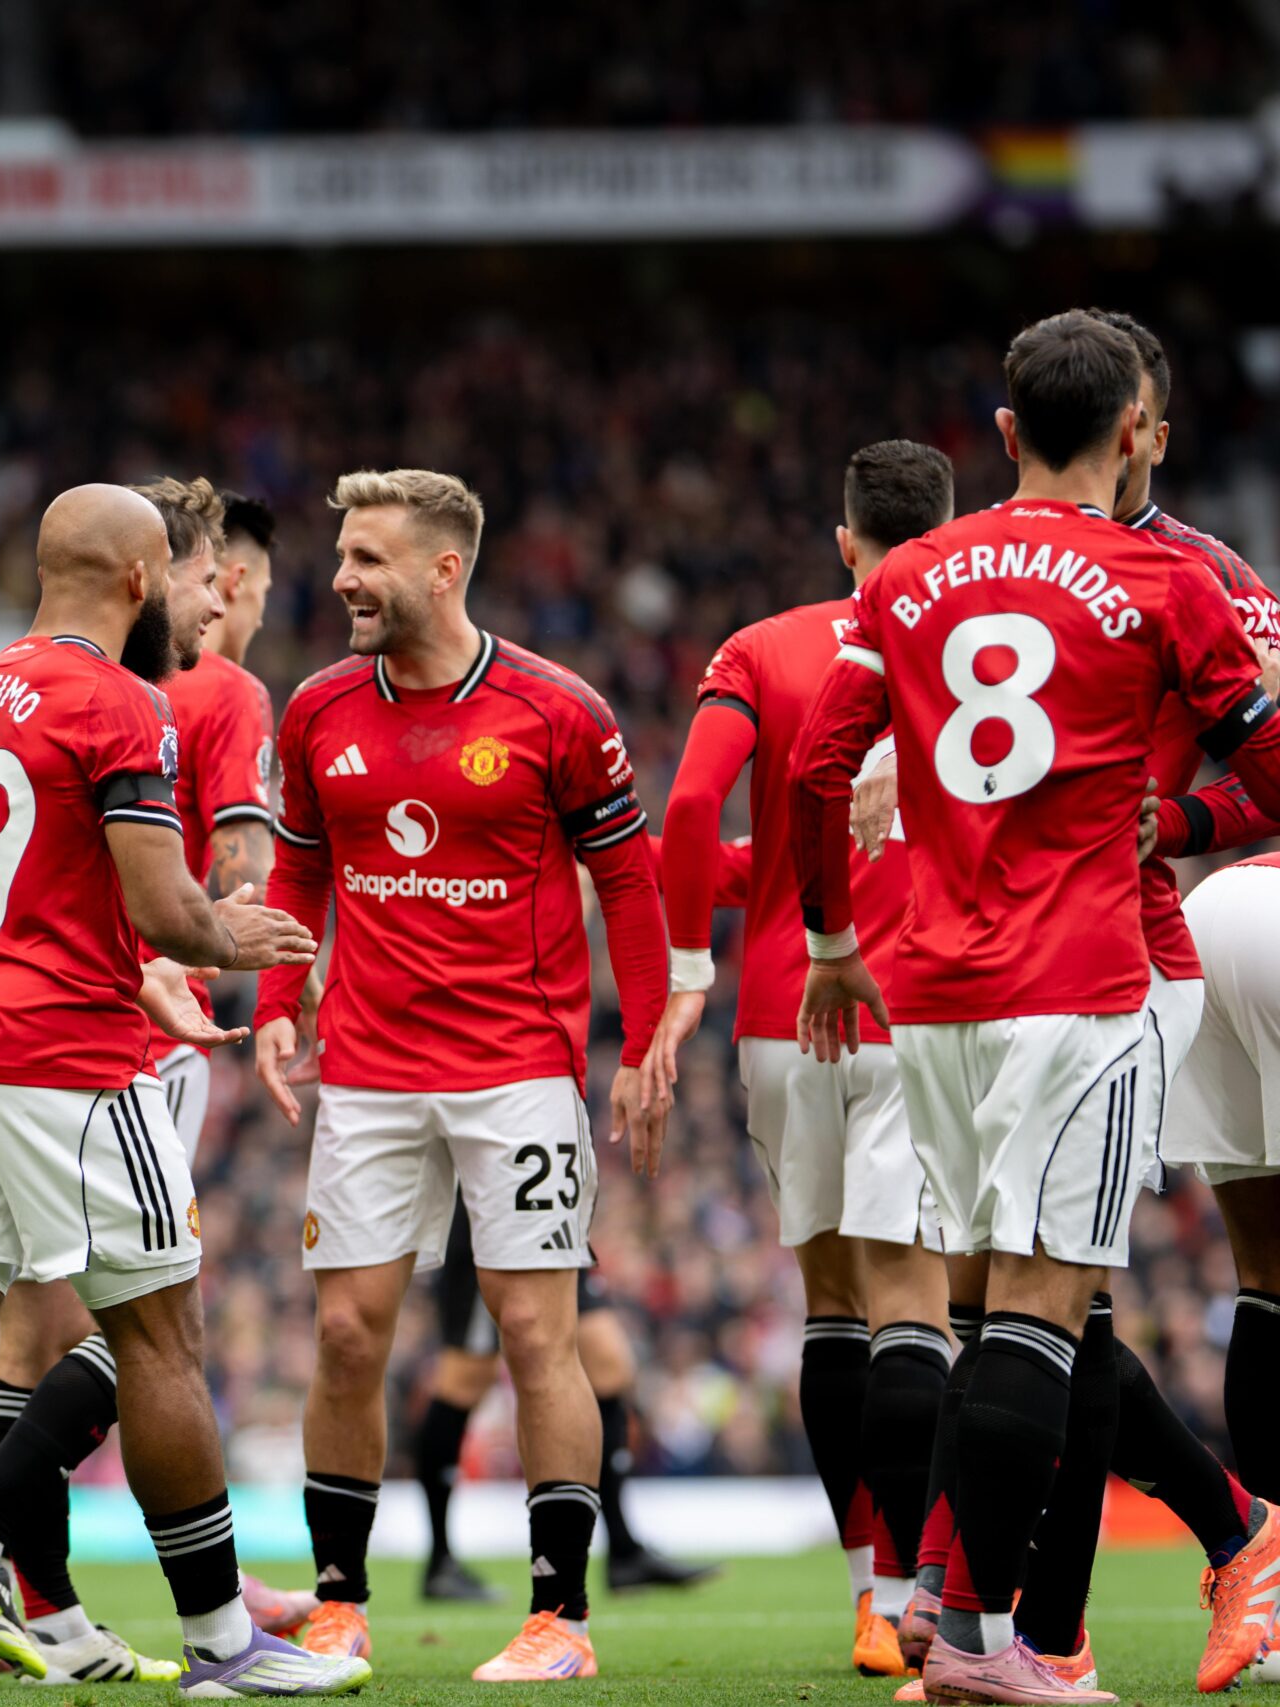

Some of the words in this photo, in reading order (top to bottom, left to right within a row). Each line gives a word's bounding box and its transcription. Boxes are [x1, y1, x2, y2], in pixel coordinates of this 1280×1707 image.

[890, 542, 1144, 640] B.FERNANDES
[934, 611, 1057, 804] 8
[343, 863, 508, 908] Snapdragon
[514, 1142, 581, 1212] 23
